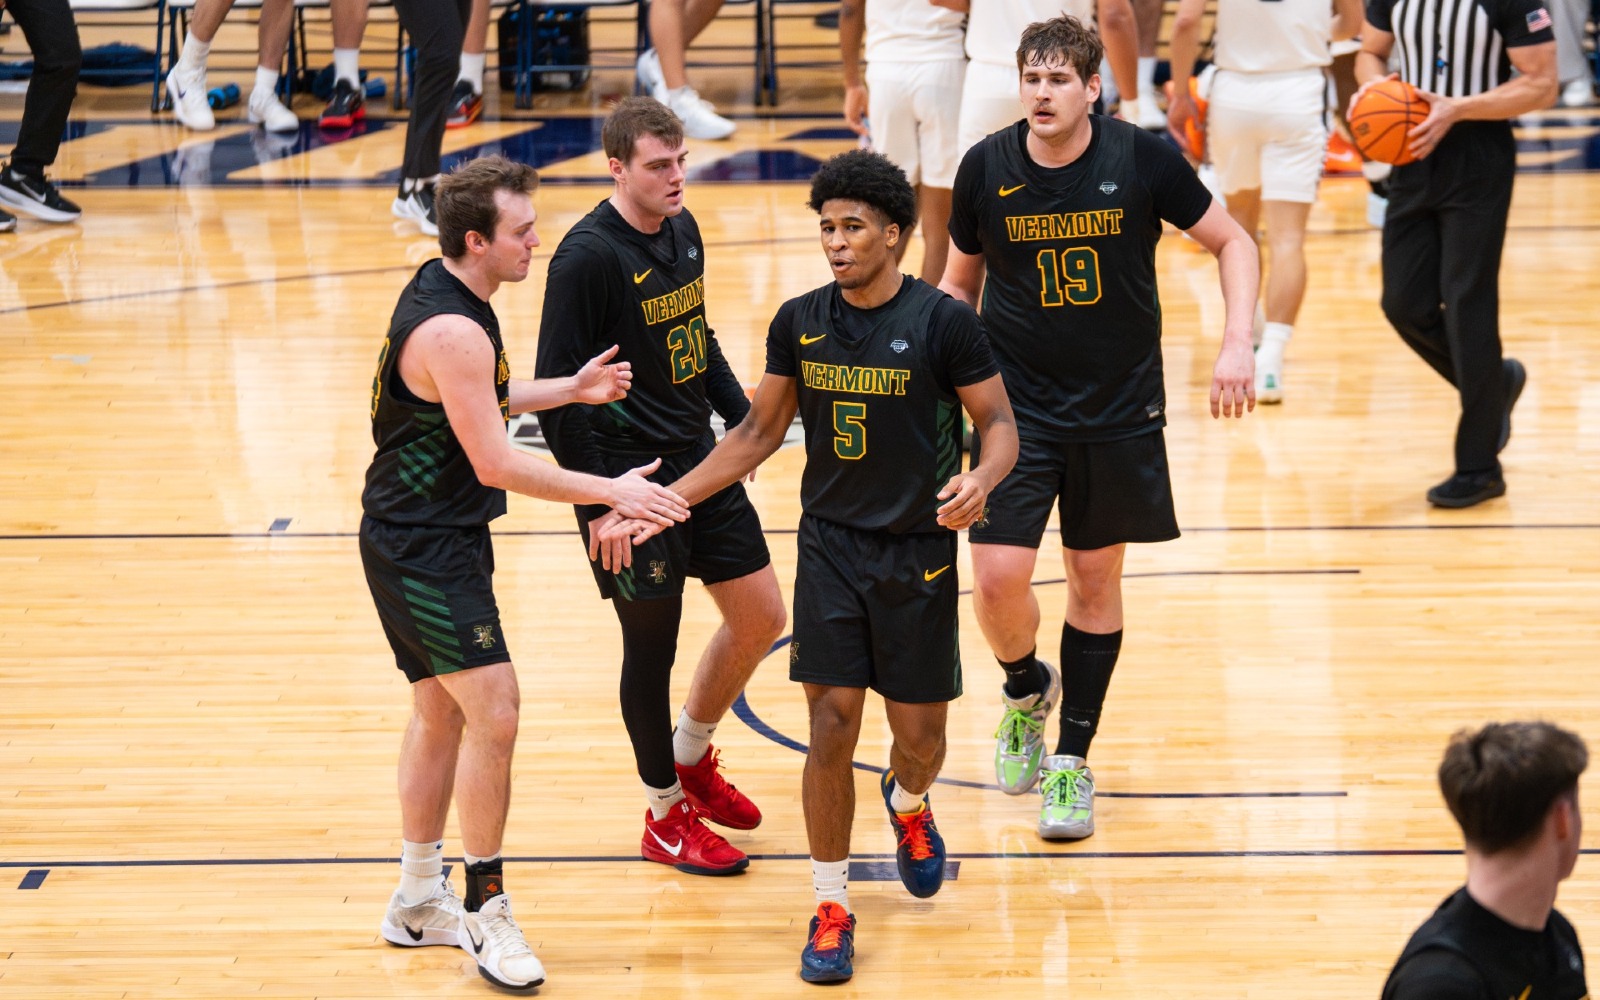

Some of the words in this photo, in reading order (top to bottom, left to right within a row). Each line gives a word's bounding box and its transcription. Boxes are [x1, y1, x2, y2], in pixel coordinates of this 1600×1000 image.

[1005, 208, 1123, 242] VERMONT
[1036, 246, 1102, 307] 19
[666, 315, 707, 384] 20
[801, 360, 911, 396] VERMONT
[833, 401, 867, 460] 5
